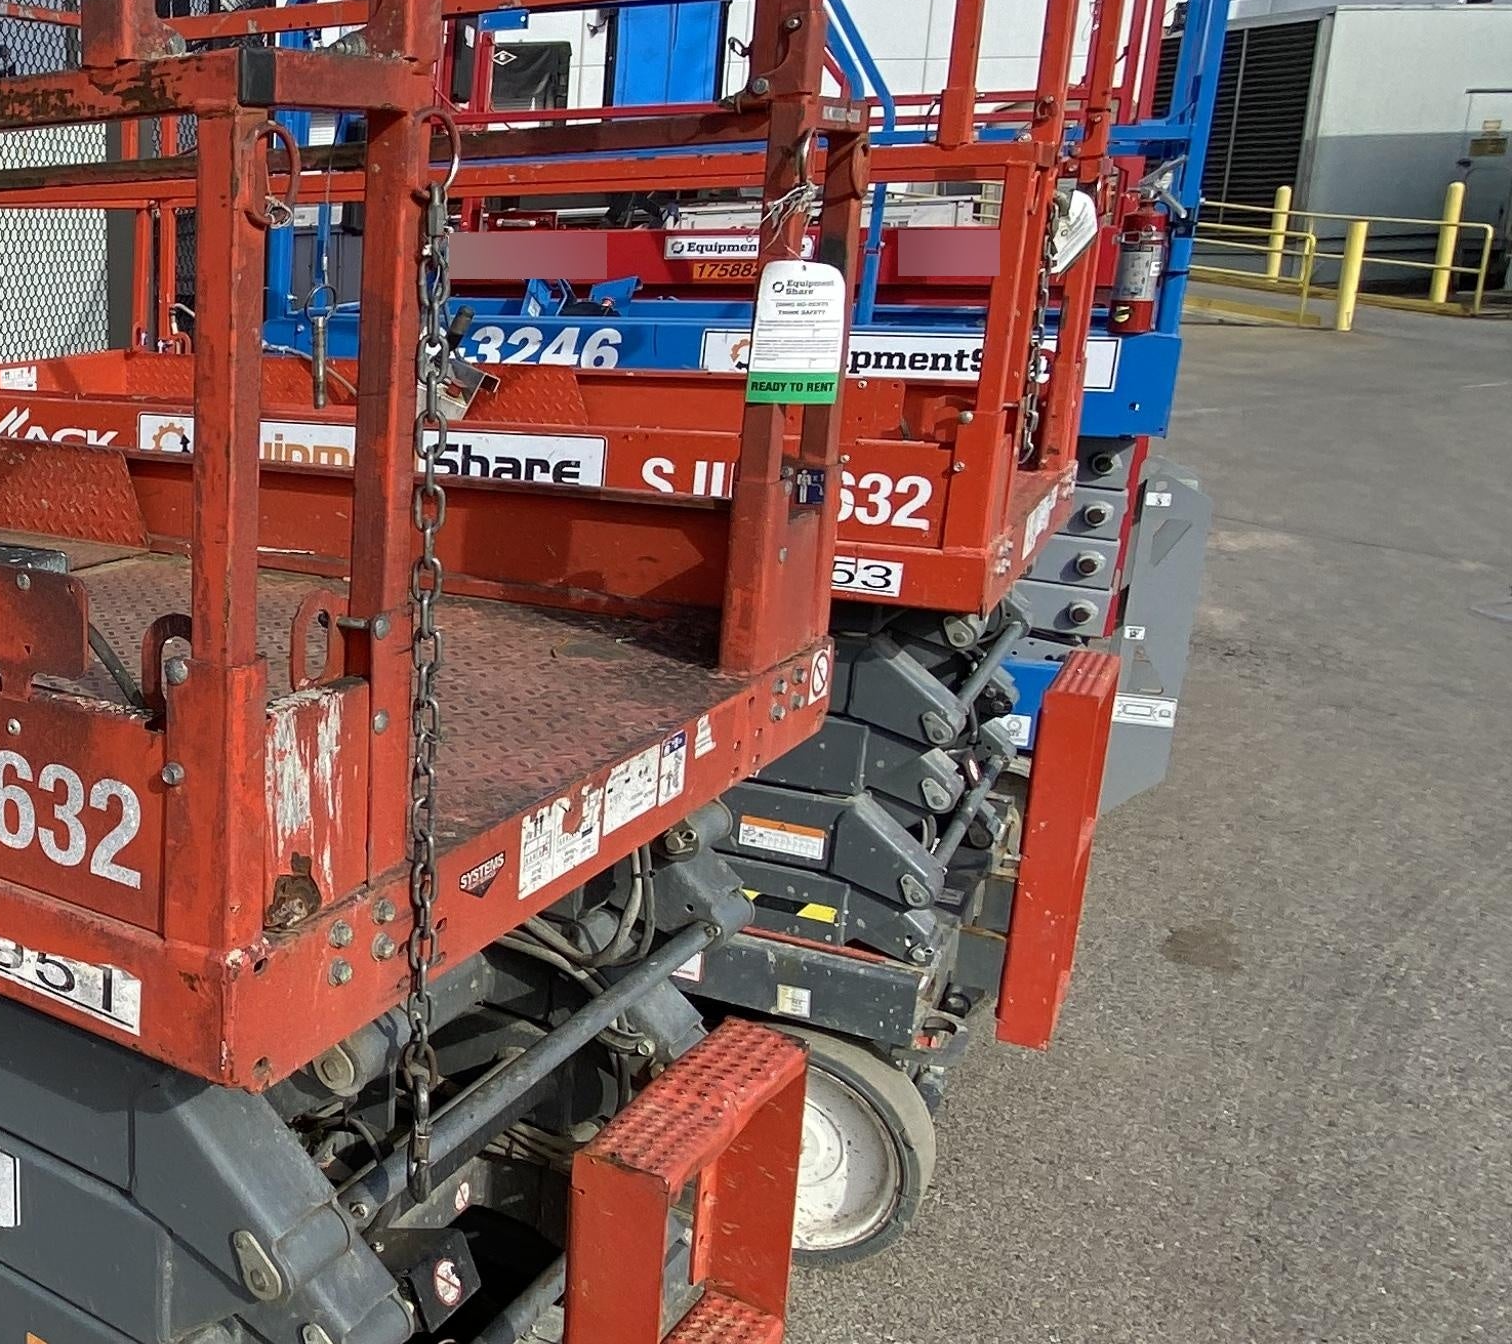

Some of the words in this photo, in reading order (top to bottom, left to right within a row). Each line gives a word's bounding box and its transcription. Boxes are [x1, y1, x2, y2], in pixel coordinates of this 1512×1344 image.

[687, 241, 757, 254] Equipmen
[750, 381, 787, 392] READY
[789, 382, 804, 392] TO
[806, 382, 835, 392] RENT
[838, 470, 933, 532] 632
[461, 852, 504, 889] SYSTEMS
